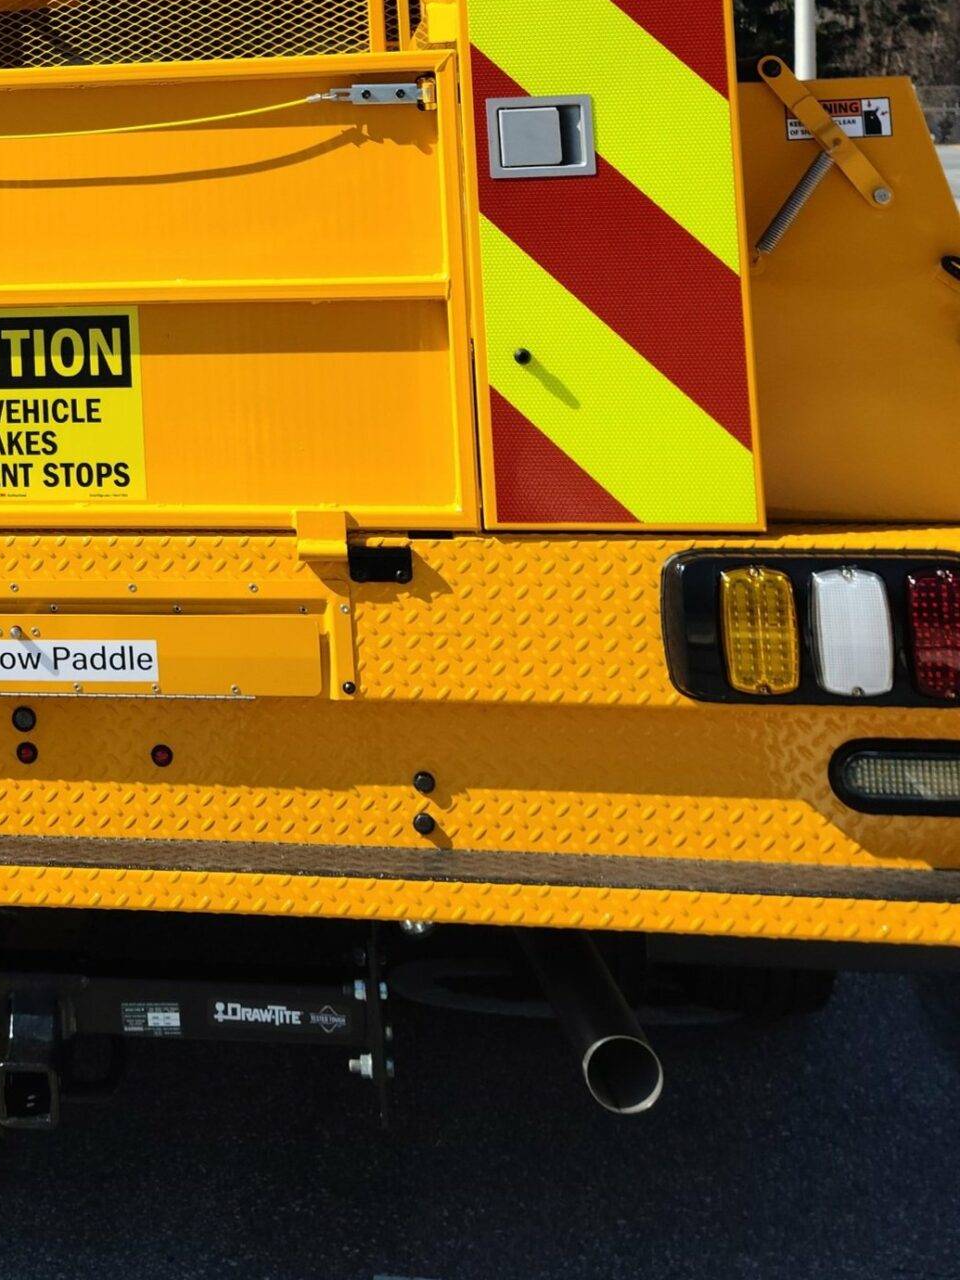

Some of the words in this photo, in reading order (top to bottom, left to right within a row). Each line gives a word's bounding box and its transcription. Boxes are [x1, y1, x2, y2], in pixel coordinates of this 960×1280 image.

[822, 101, 859, 114] NING
[42, 462, 131, 488] STOPS
[53, 645, 153, 671] Paddle
